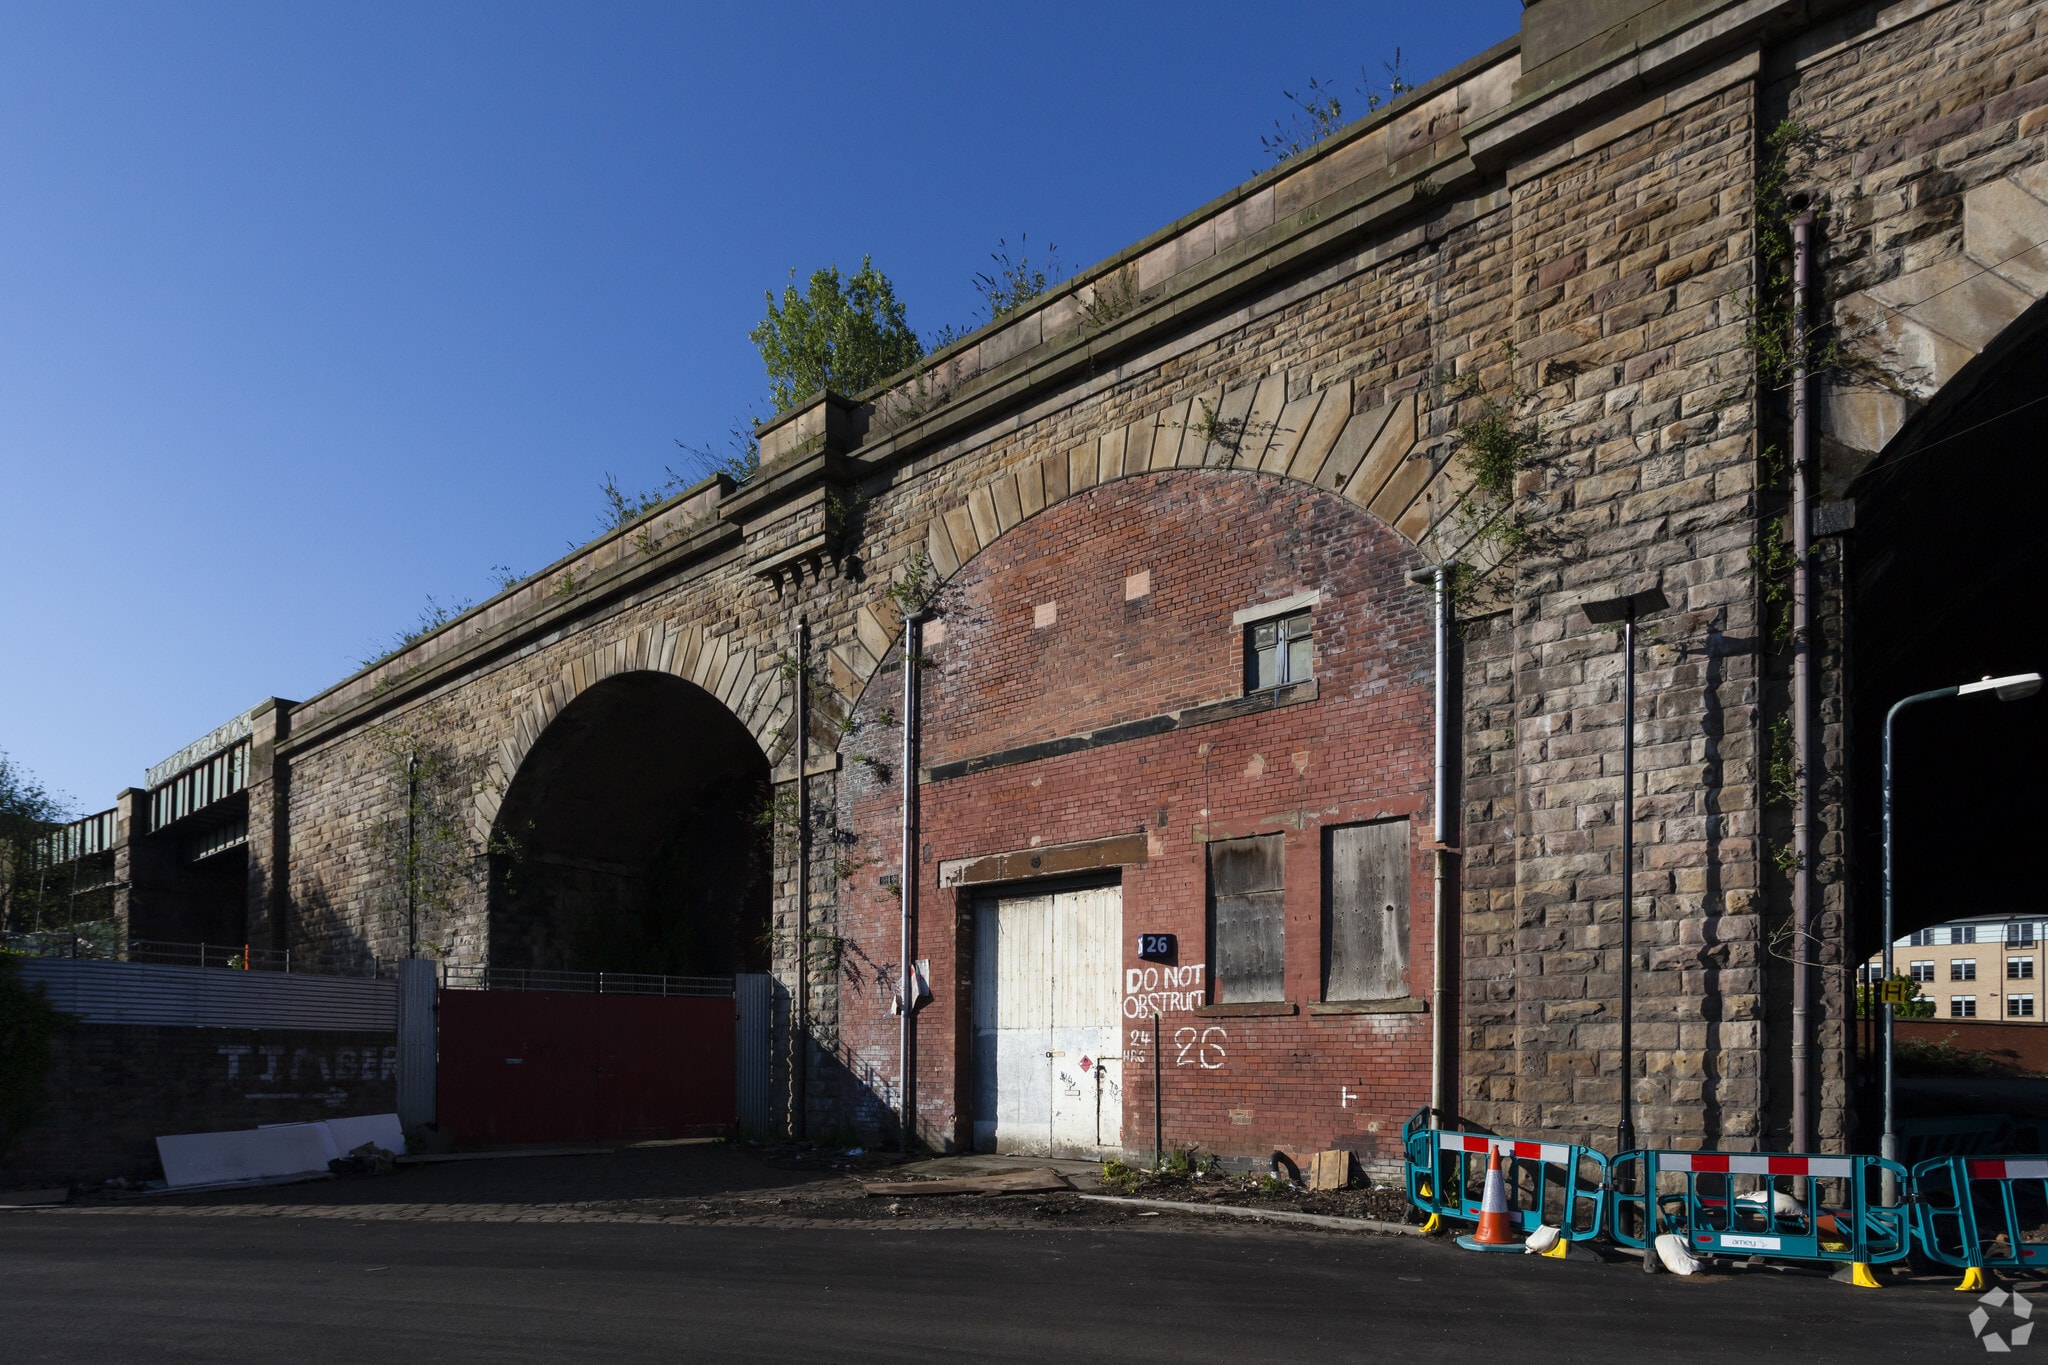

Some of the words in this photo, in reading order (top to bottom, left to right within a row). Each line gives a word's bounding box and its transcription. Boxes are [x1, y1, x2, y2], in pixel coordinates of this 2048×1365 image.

[1147, 936, 1168, 953] 26
[1126, 967, 1159, 995] DO
[1164, 963, 1206, 989] NOT
[1123, 989, 1206, 1019] OBSTRUCT
[1130, 1029, 1152, 1047] 24
[1174, 1026, 1228, 1070] 26
